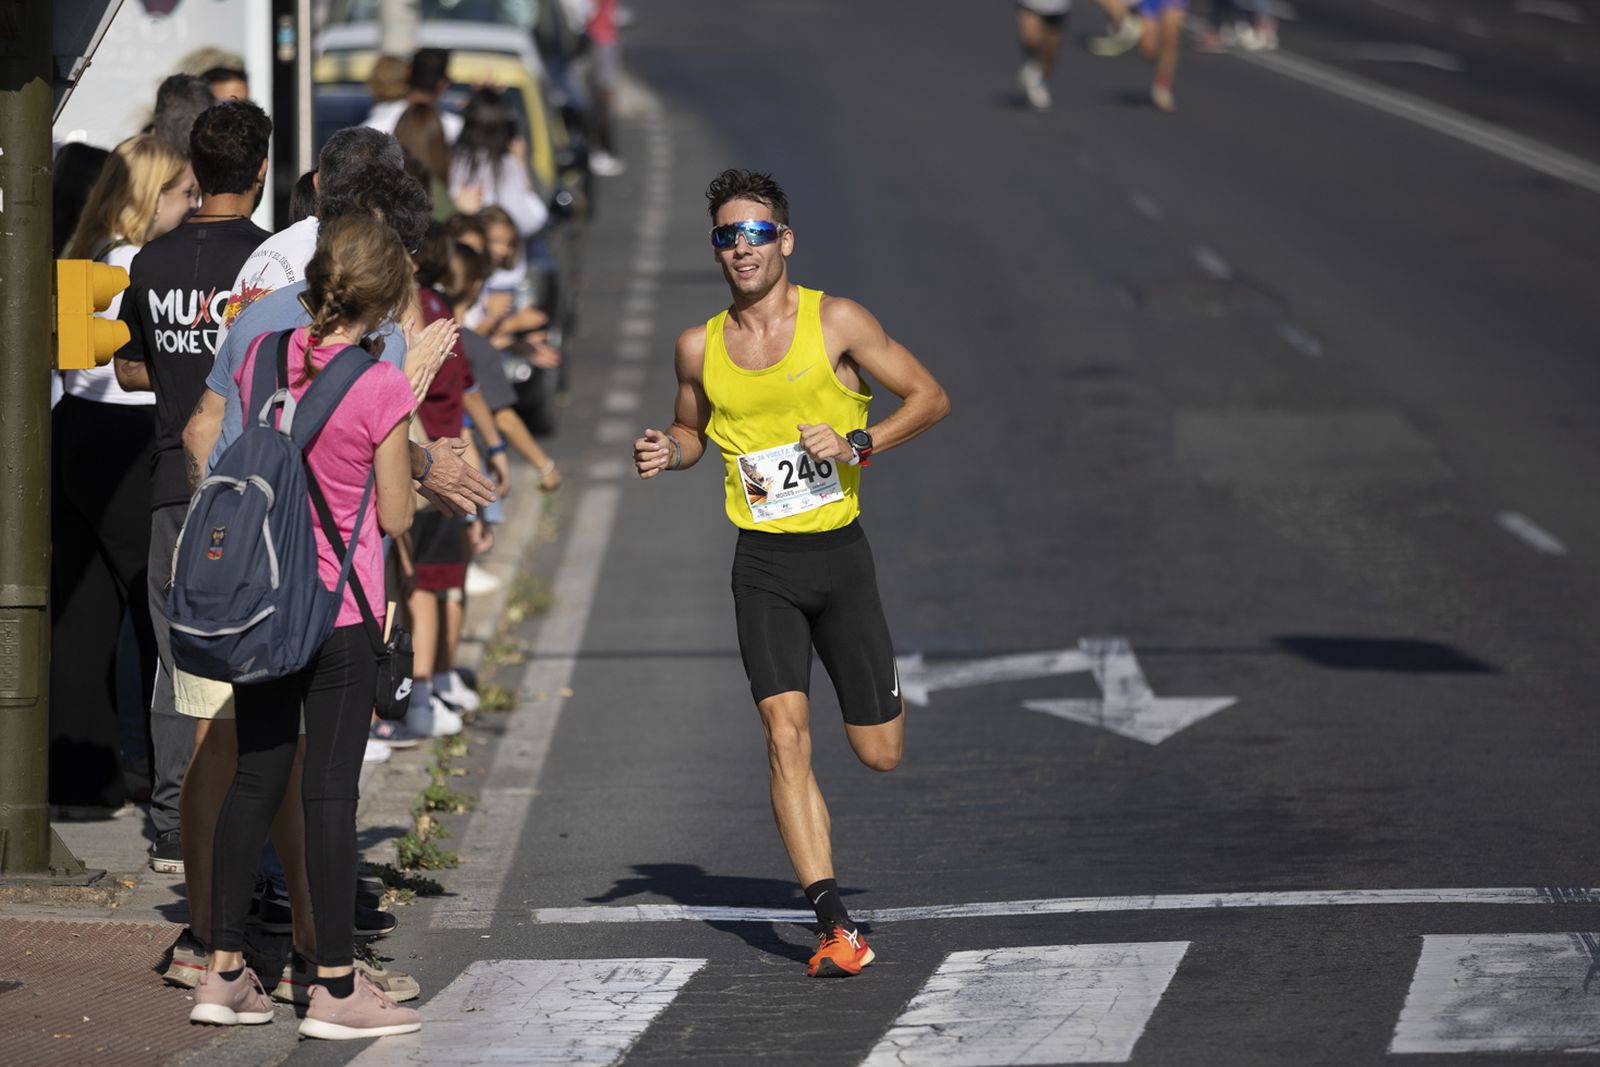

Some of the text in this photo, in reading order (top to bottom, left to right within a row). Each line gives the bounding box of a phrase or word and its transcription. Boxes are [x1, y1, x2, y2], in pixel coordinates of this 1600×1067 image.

[278, 256, 296, 284] DESIER
[155, 329, 202, 353] POKE
[778, 454, 832, 490] 246
